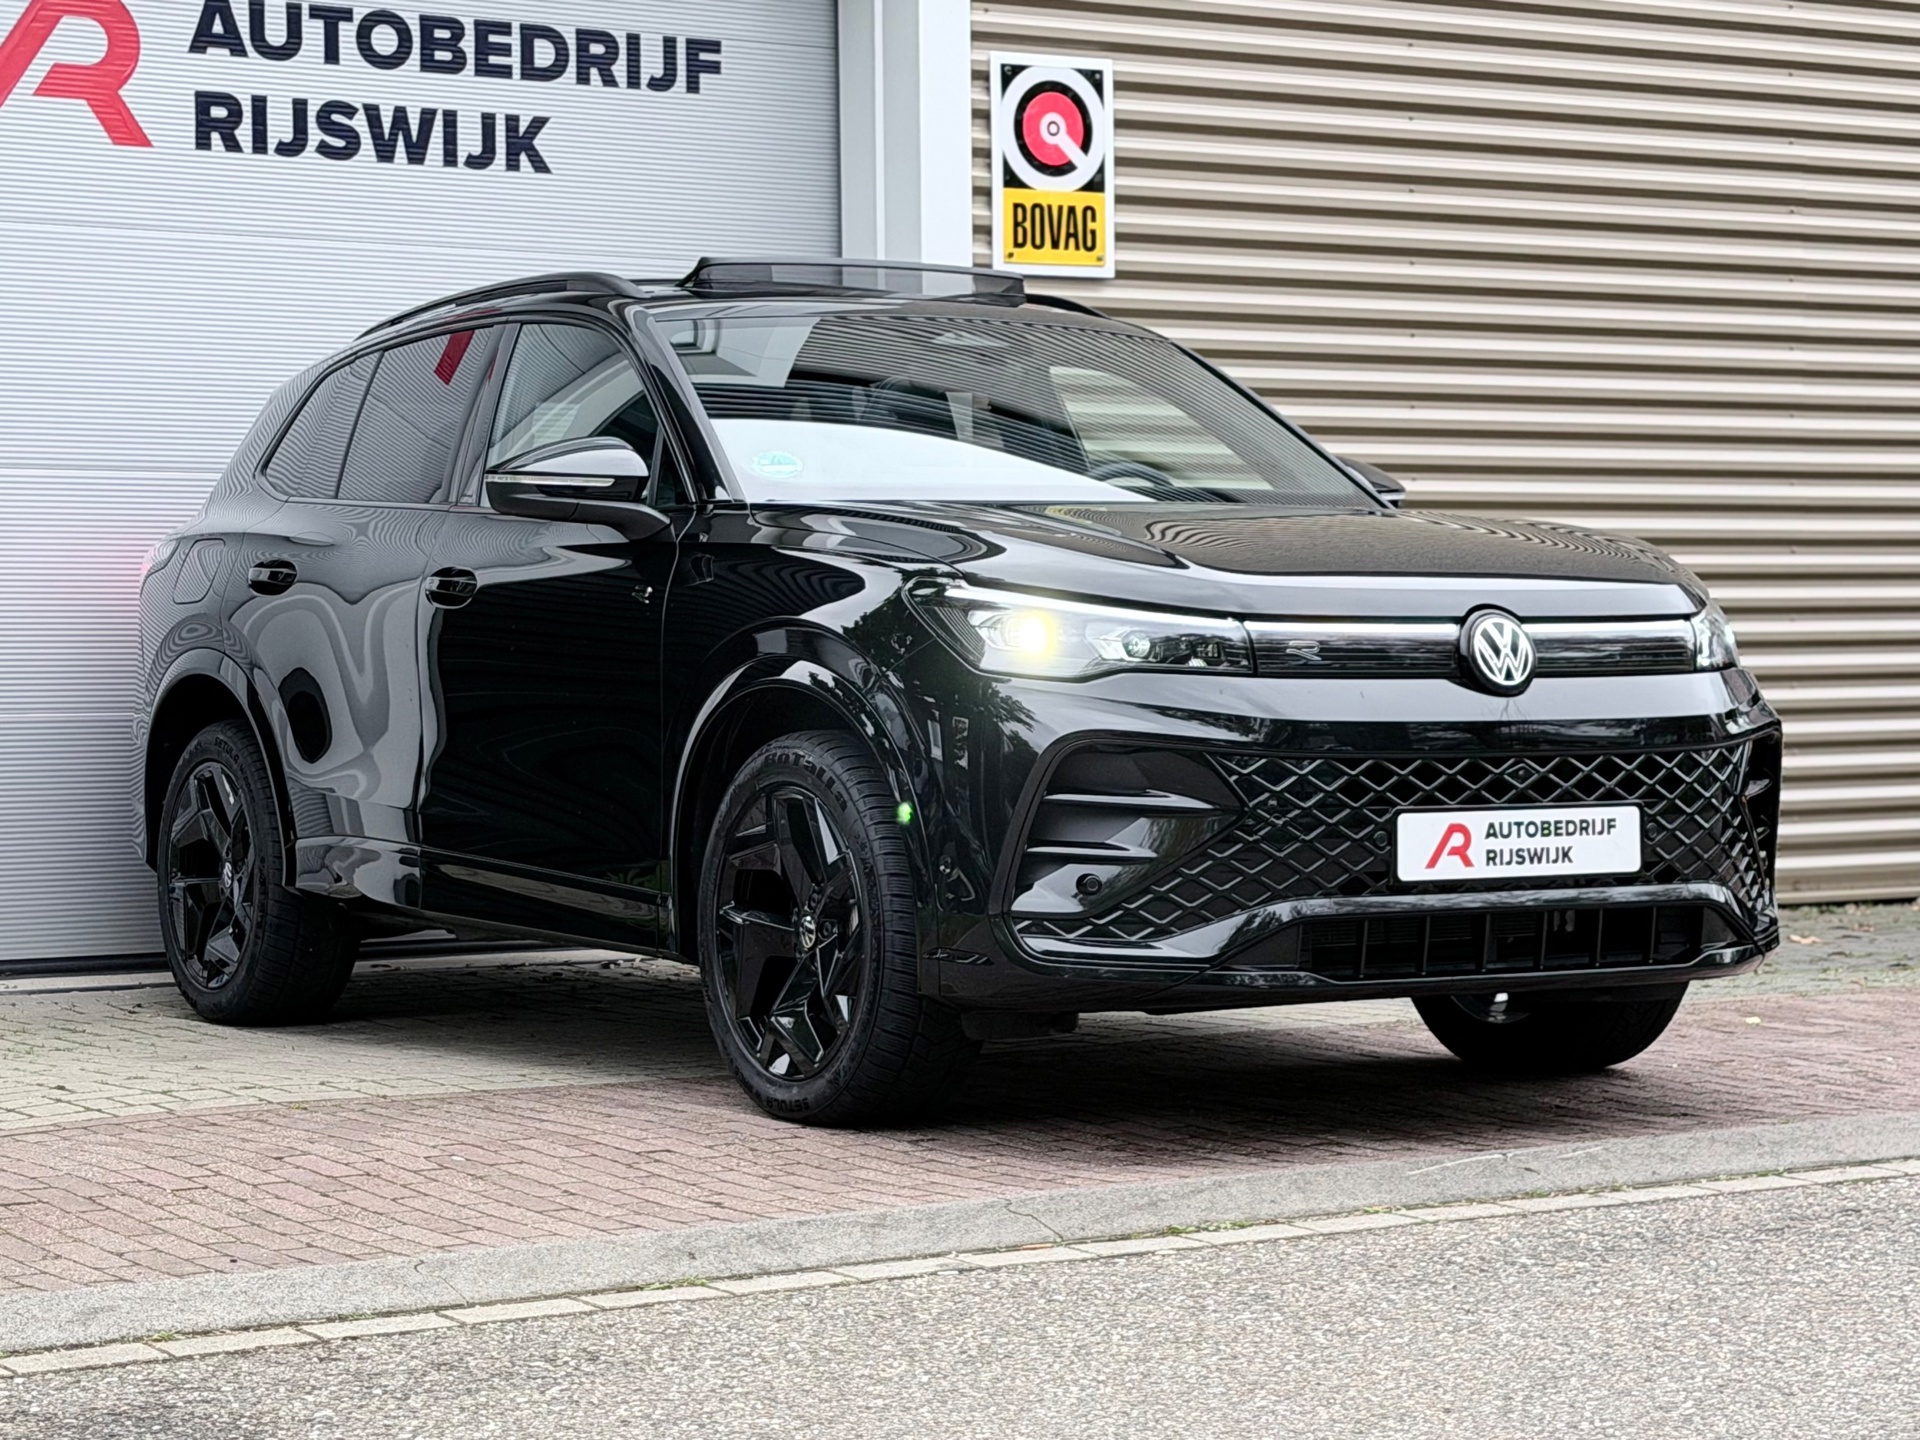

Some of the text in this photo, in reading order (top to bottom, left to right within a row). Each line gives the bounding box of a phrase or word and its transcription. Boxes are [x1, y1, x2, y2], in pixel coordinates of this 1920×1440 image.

[187, 0, 722, 95] AUTOBEDRIJF
[194, 90, 553, 175] RIJSWIJK
[1012, 202, 1097, 253] BOVAG
[1484, 817, 1618, 841] AUTOBEDRIJF
[1485, 845, 1574, 867] RIJSWIJK
